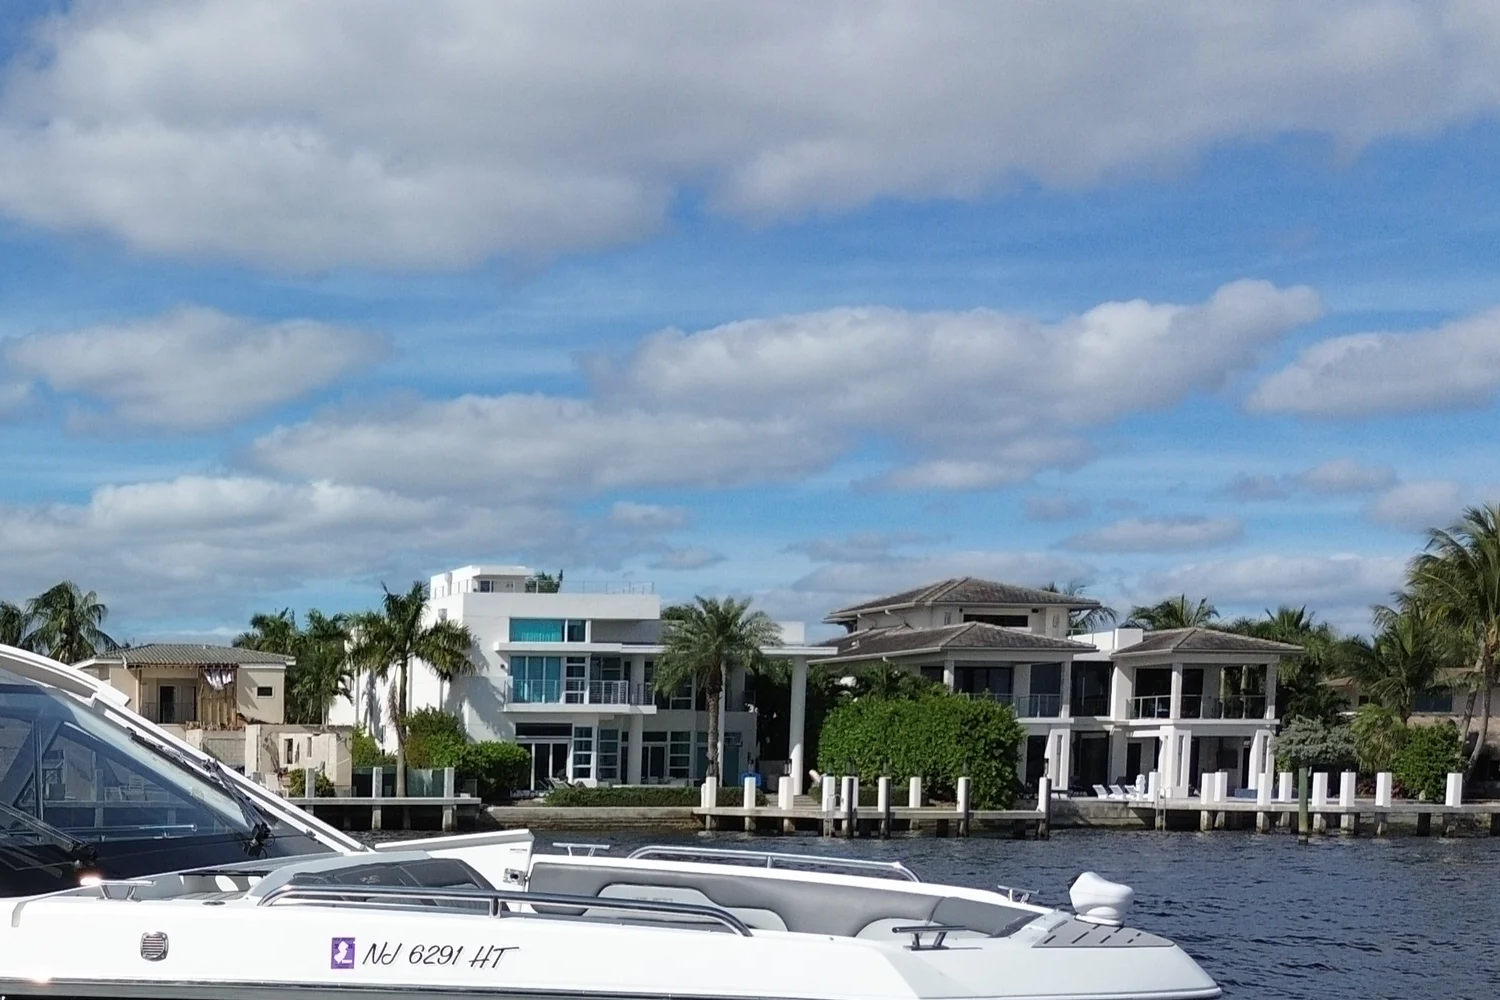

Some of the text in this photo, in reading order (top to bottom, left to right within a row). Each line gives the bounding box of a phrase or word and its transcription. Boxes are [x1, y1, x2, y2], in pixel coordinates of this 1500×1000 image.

[362, 941, 520, 969] NJ 6291 HT
